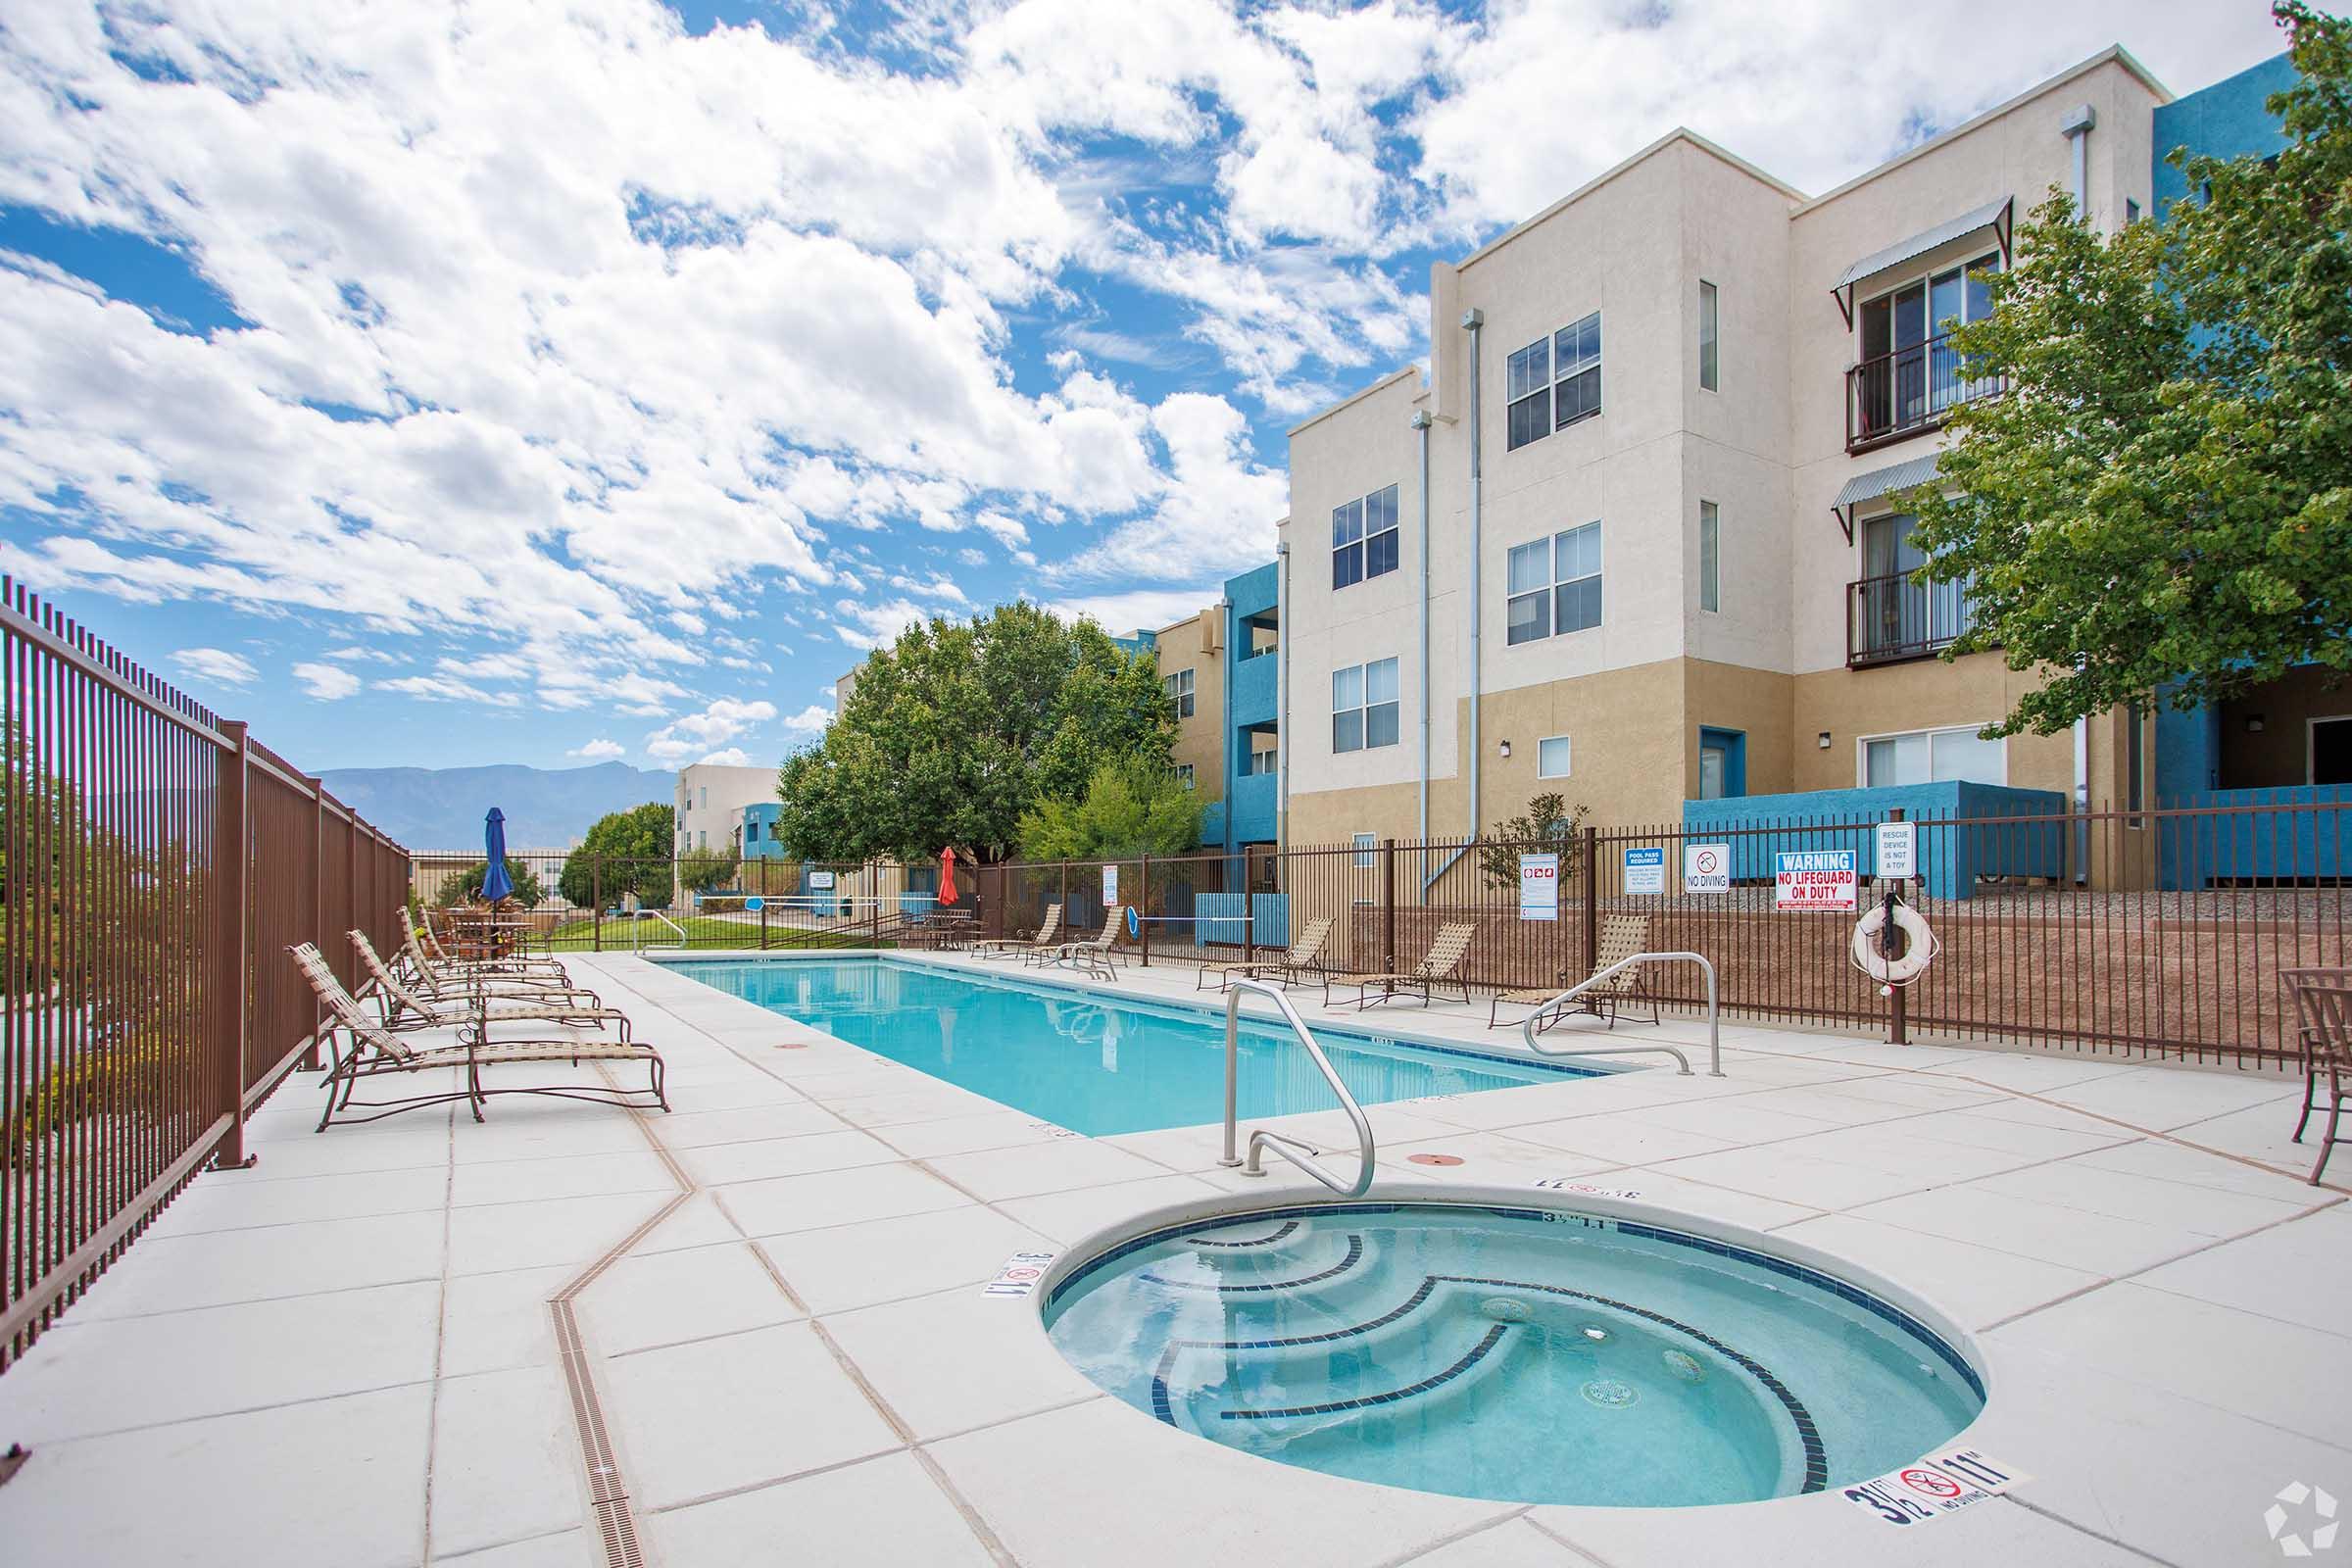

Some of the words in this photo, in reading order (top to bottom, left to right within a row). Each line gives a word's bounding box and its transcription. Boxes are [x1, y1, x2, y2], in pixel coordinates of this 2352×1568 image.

[1783, 853, 1849, 871] WARNING
[1688, 876, 1699, 887] NO
[1700, 875, 1726, 887] DIVING
[1779, 872, 1791, 885] NO
[1796, 871, 1852, 885] LIFEGUARD
[1791, 886, 1806, 899] ON
[1810, 886, 1838, 899] DUTY
[1940, 1498, 1960, 1511] NO
[1958, 1490, 1989, 1507] DIVING
